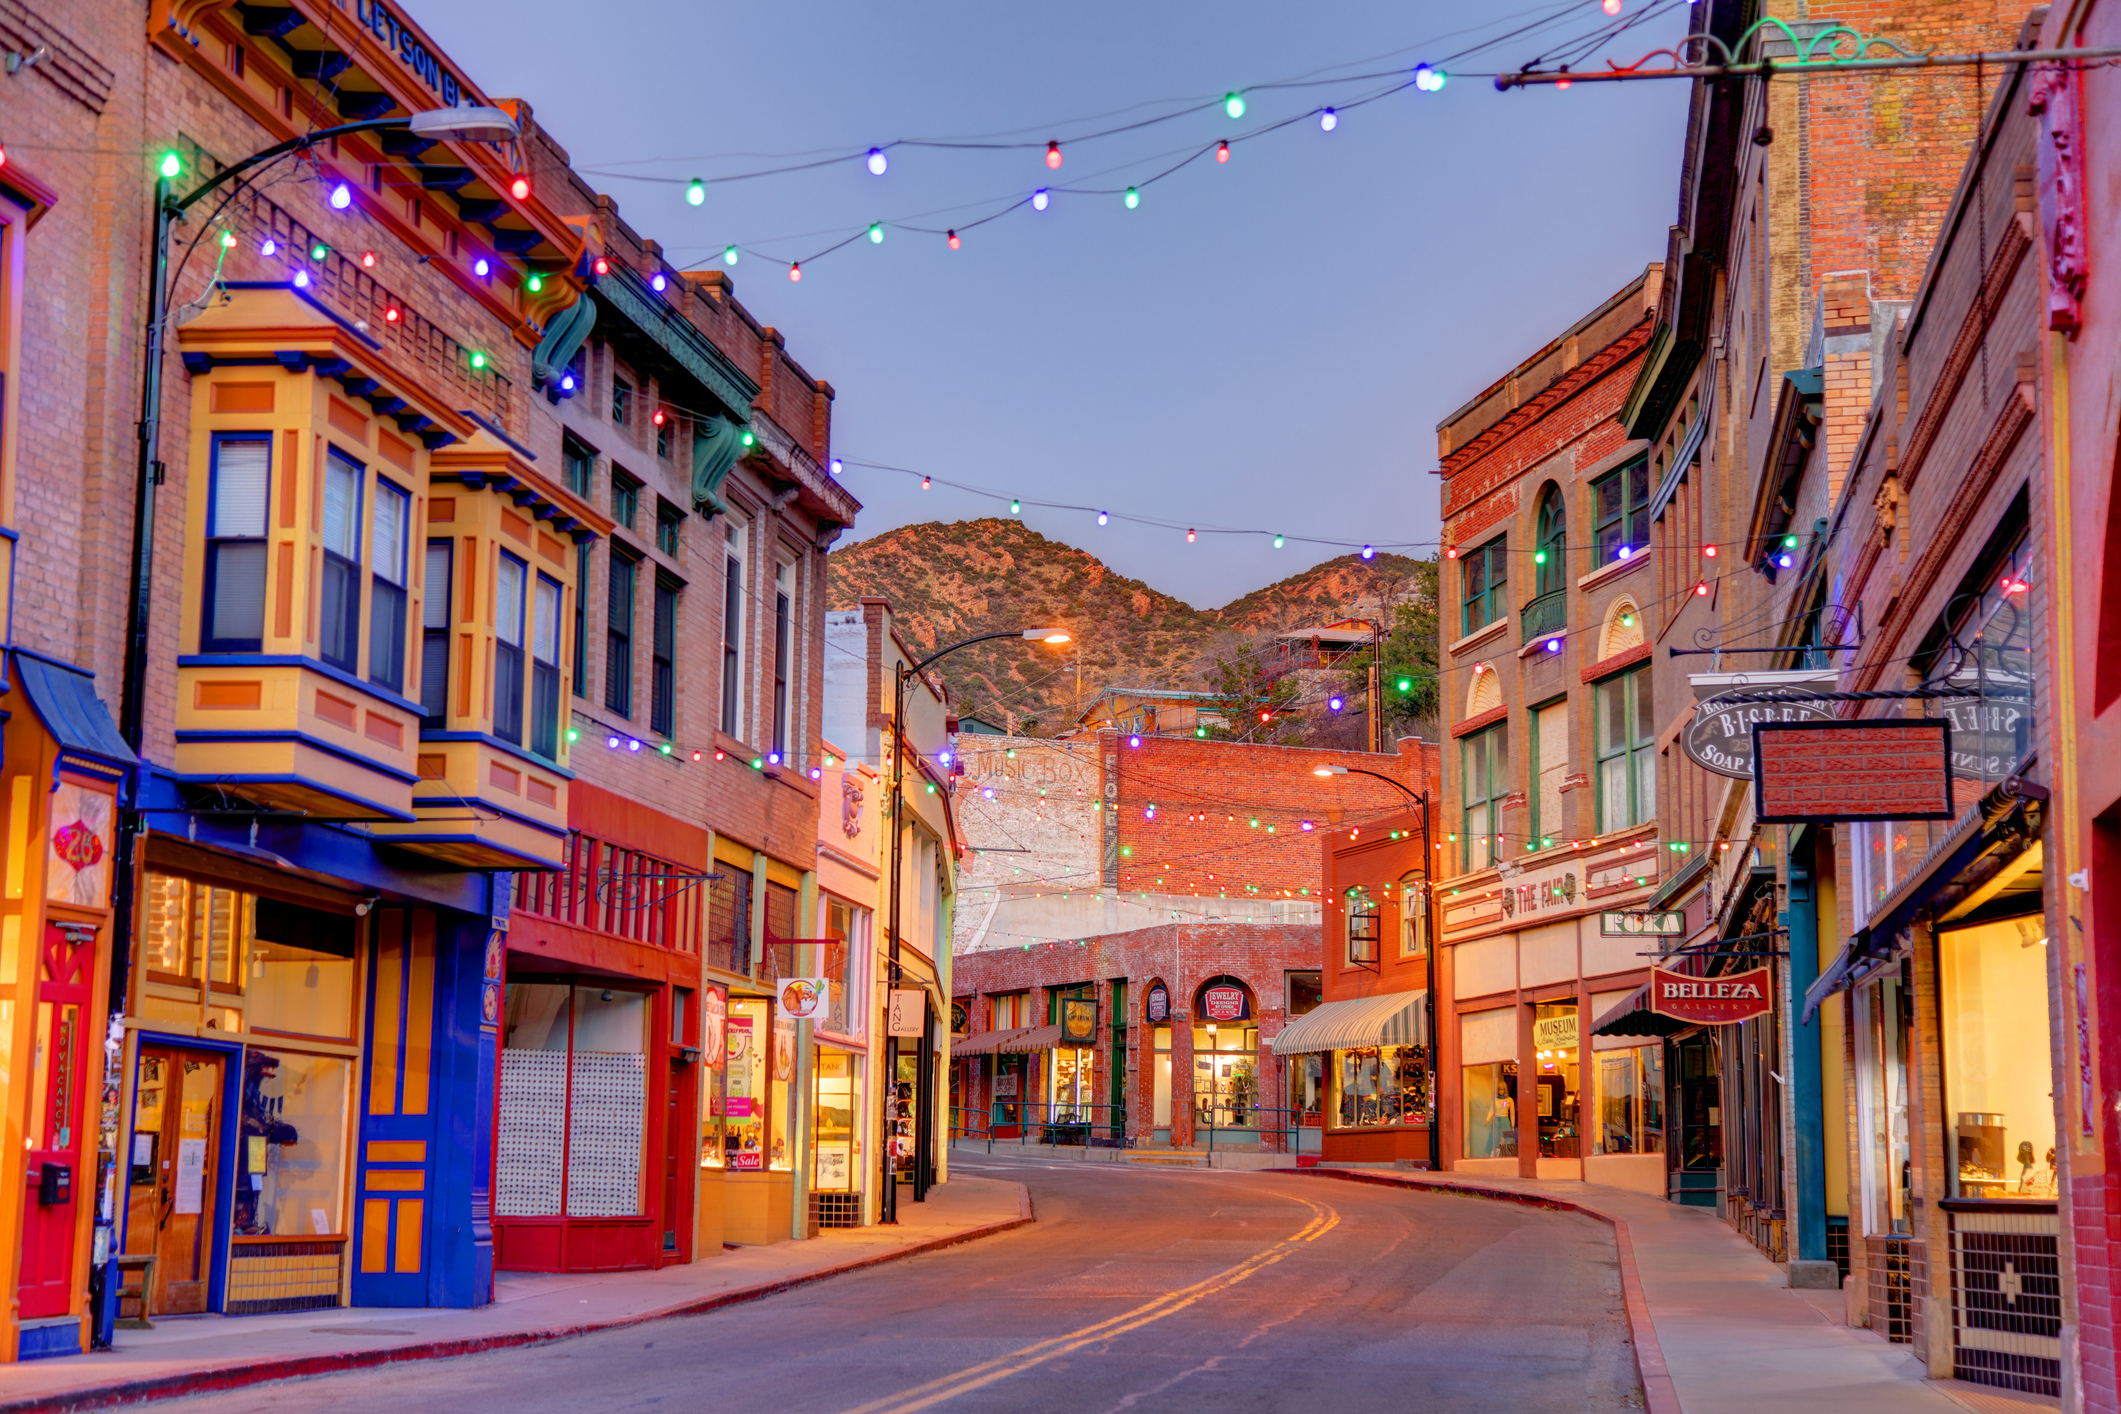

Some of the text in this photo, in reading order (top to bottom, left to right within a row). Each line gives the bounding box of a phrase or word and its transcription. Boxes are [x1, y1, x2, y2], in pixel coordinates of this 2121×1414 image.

[357, 0, 439, 91] LETSON
[1732, 739, 1749, 752] 25
[1701, 744, 1745, 771] SOAP
[1516, 877, 1564, 913] THE FAIR
[1604, 914, 1681, 933] ROKA
[1209, 991, 1240, 1001] JEWELRY
[1662, 982, 1764, 999] BELLEZA
[1671, 1003, 1751, 1011] GALLERY
[1539, 1017, 1577, 1036] MUSEUM
[820, 1063, 844, 1071] TANG
[55, 1051, 67, 1132] VACANCY
[738, 1155, 760, 1166] Sale
